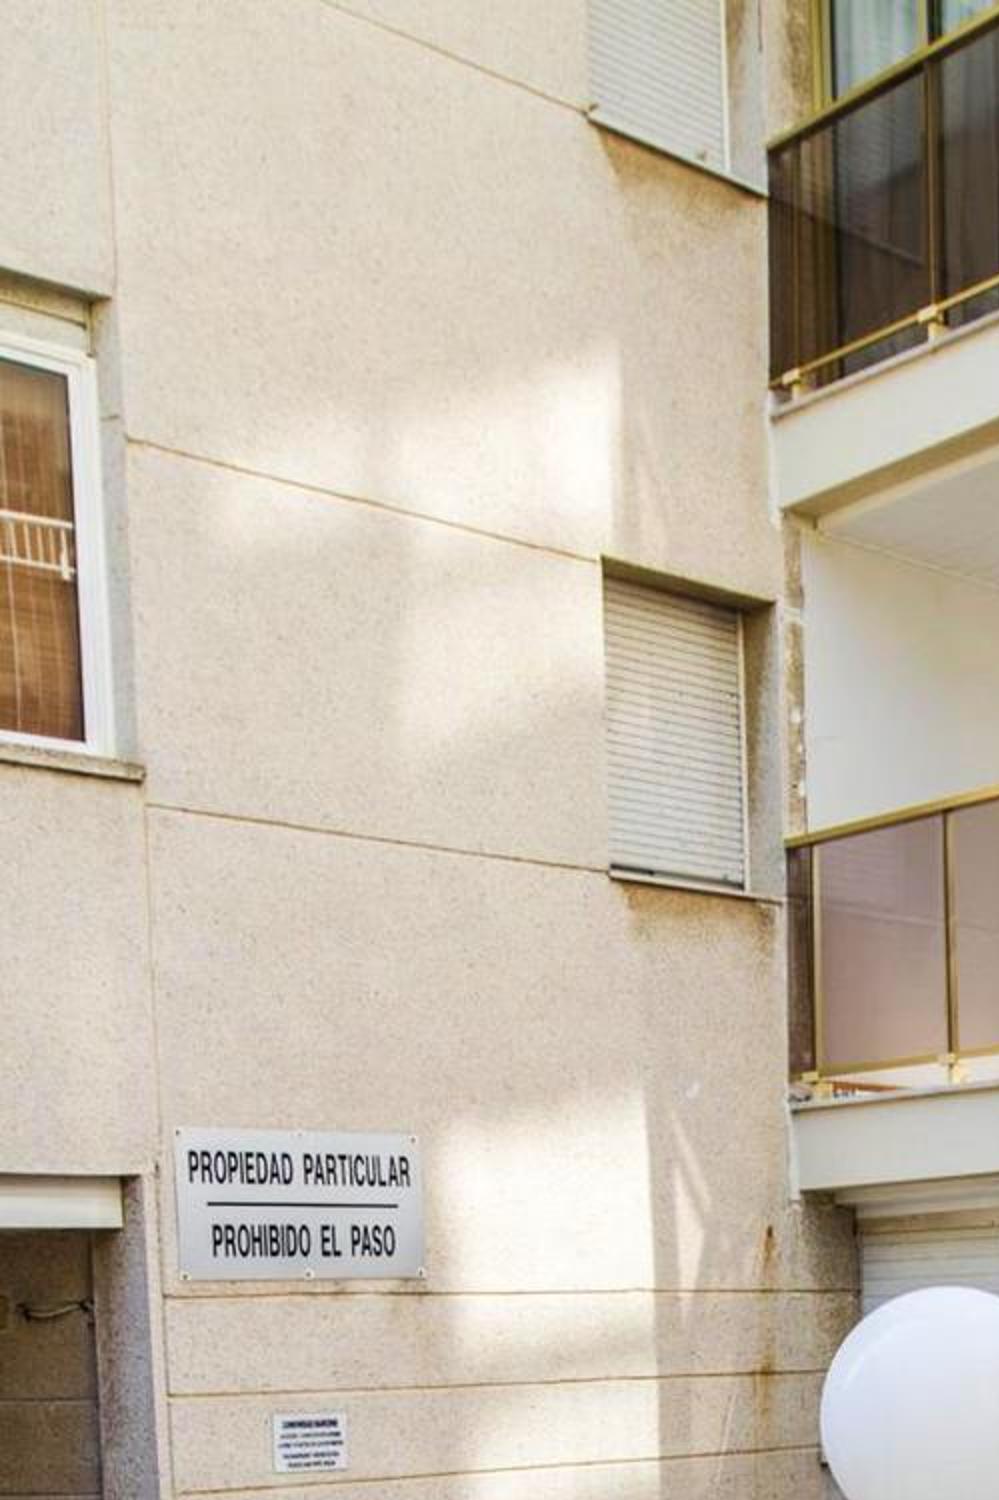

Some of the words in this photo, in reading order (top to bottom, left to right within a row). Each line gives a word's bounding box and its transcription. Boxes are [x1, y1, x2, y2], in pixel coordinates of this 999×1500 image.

[187, 1149, 294, 1186] PROPIEDAD
[303, 1153, 411, 1187] PARTICULAR
[211, 1223, 312, 1258] PROHIBIDO
[320, 1224, 343, 1258] EL
[350, 1224, 396, 1257] PASO
